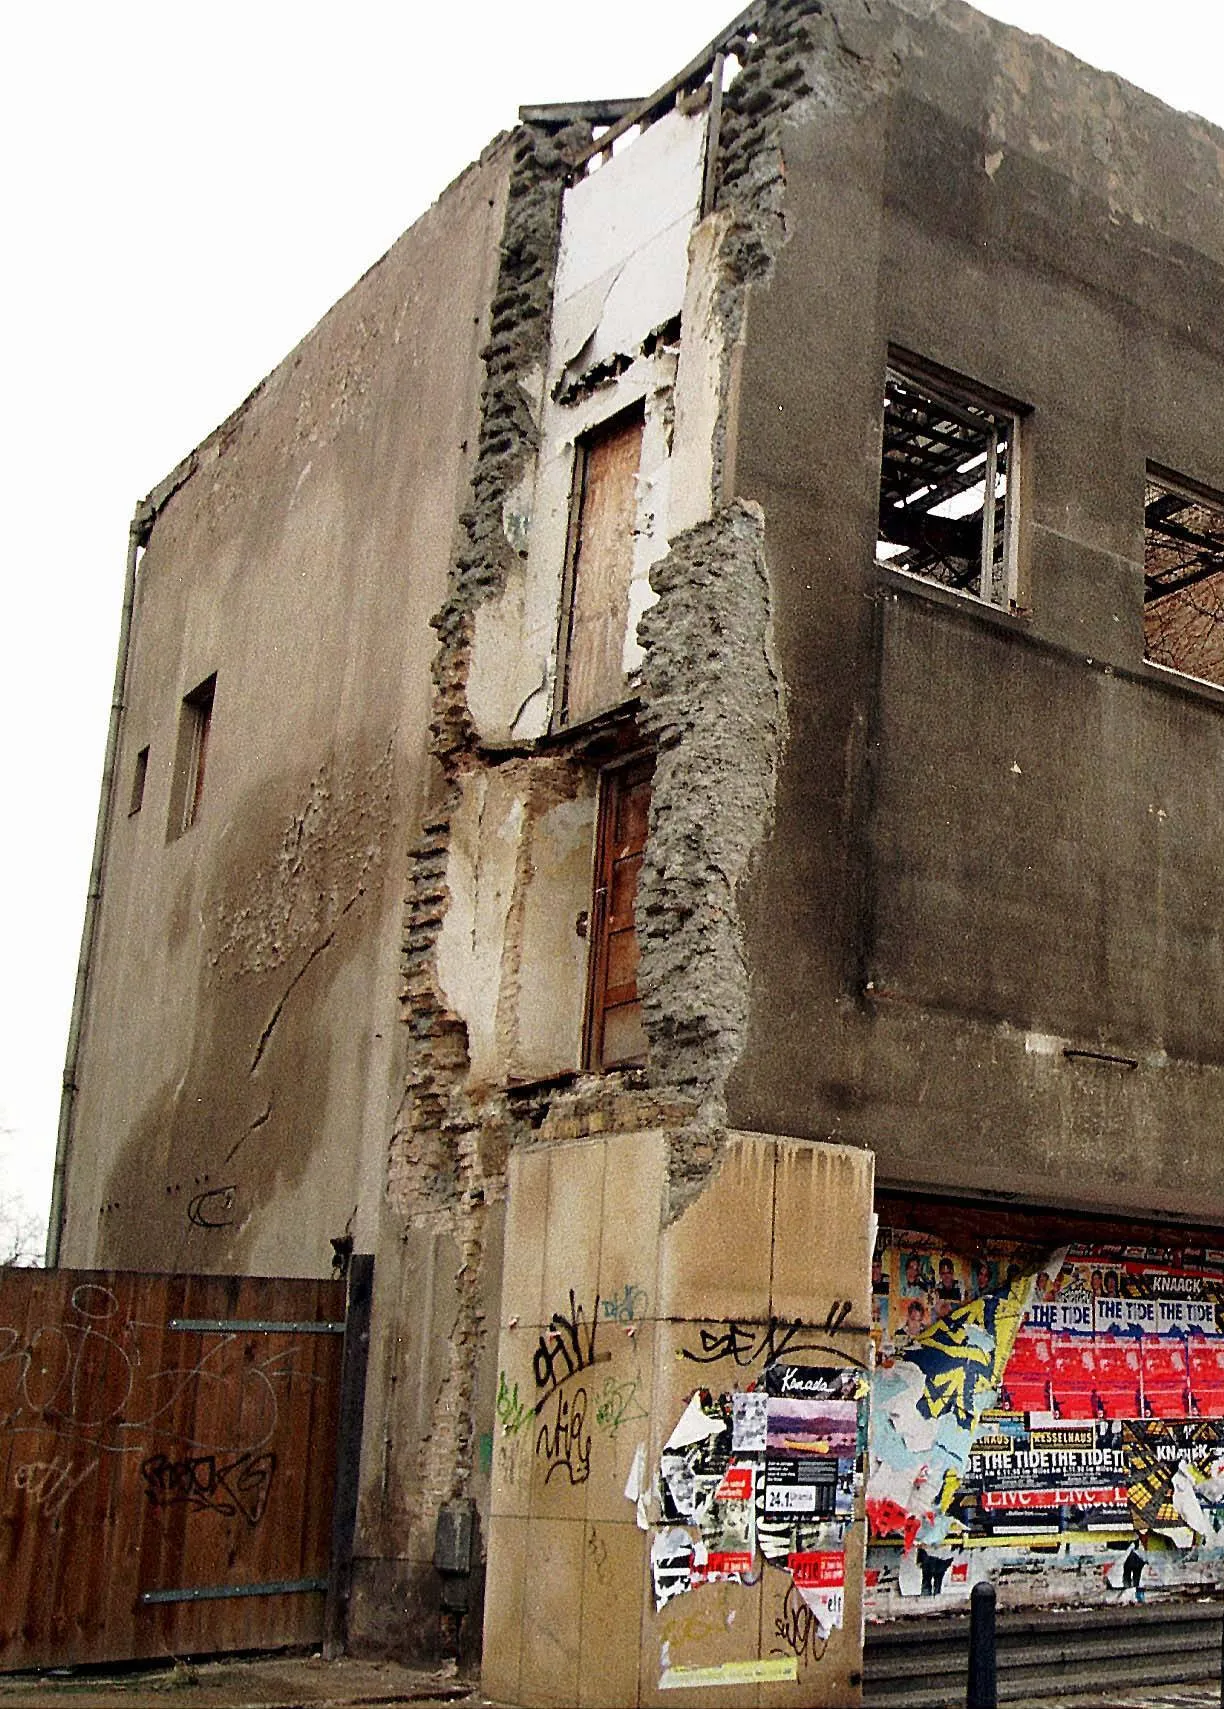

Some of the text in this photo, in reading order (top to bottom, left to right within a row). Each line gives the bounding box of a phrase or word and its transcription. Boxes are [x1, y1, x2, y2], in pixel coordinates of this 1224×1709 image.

[1153, 1277, 1201, 1293] KNAACK
[1032, 1306, 1090, 1324] THE TIDE
[1098, 1300, 1154, 1320] THE TIDE
[1159, 1301, 1213, 1322] THE TIDE
[782, 1367, 836, 1393] Kanada
[985, 1453, 1012, 1470] THE
[1015, 1450, 1050, 1469] TIDE
[1050, 1450, 1077, 1467] THE
